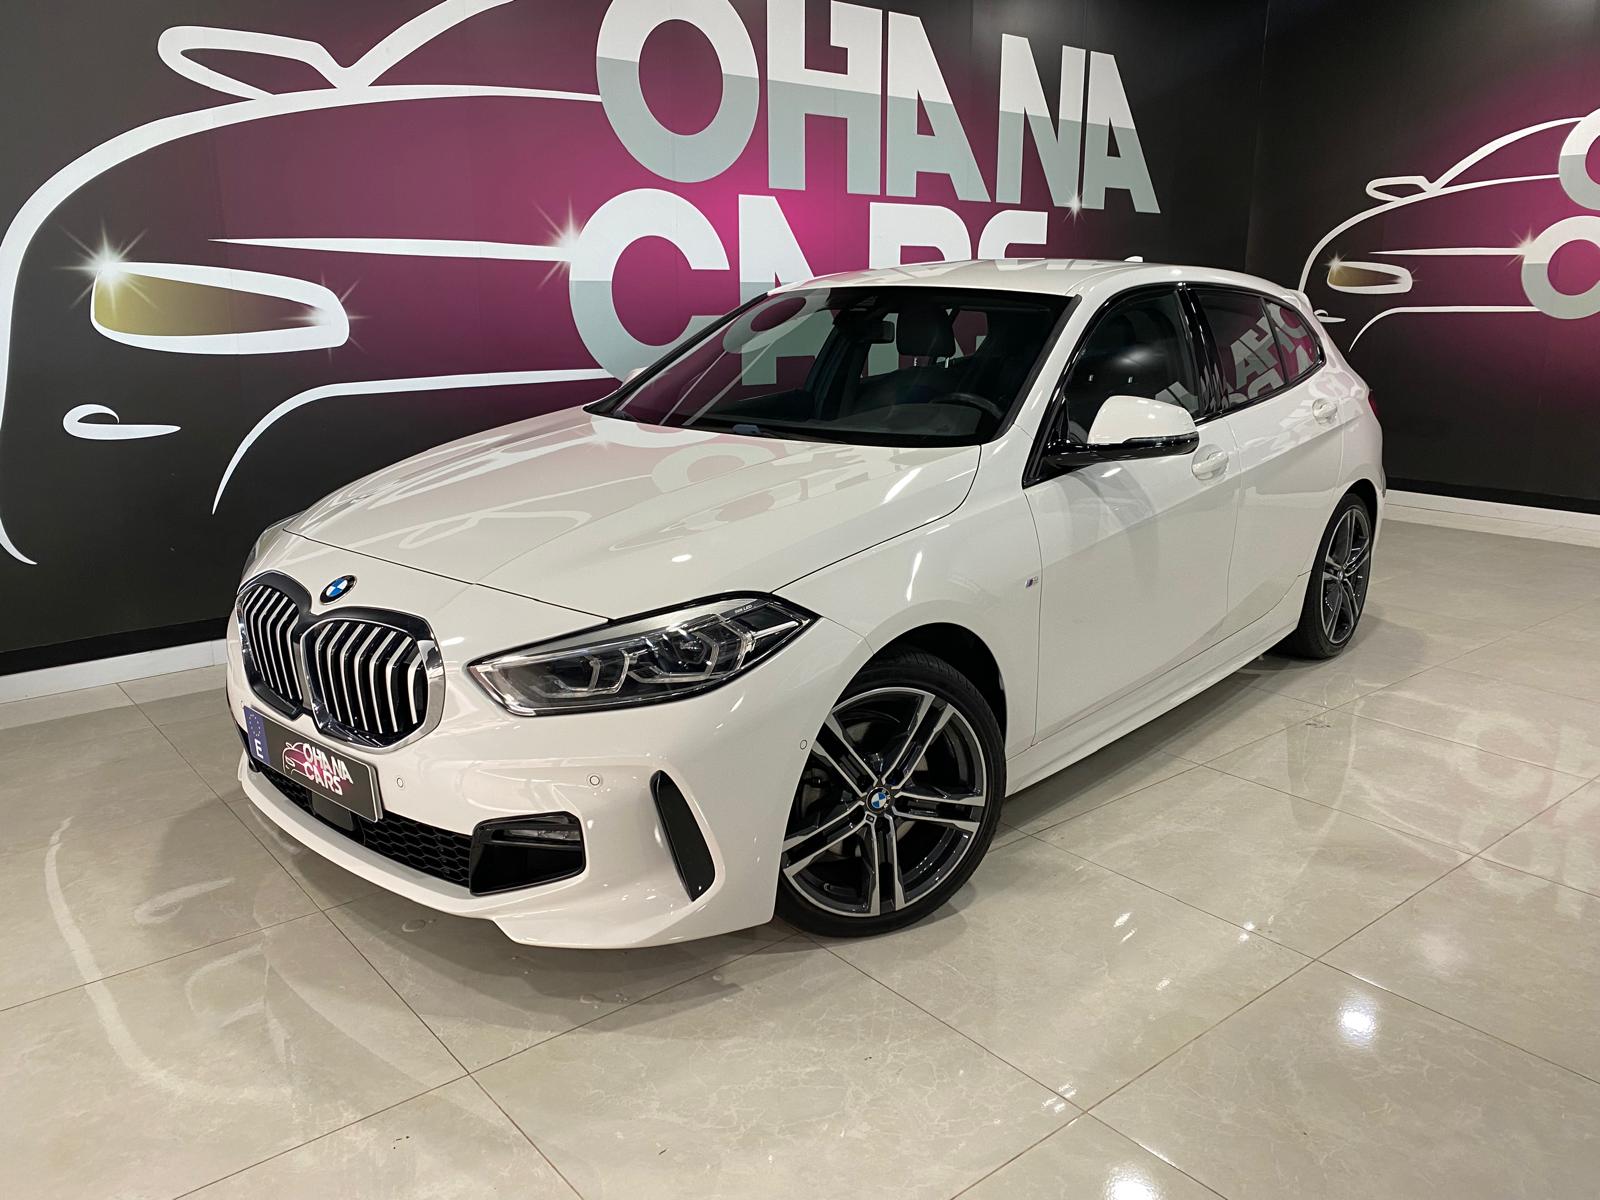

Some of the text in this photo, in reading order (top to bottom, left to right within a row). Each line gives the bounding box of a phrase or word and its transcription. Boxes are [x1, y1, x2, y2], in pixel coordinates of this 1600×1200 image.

[596, 0, 1160, 213] OHANA
[569, 188, 1048, 386] CA
[254, 738, 264, 759] E
[302, 743, 354, 785] OHANA
[303, 761, 343, 796] CARS
